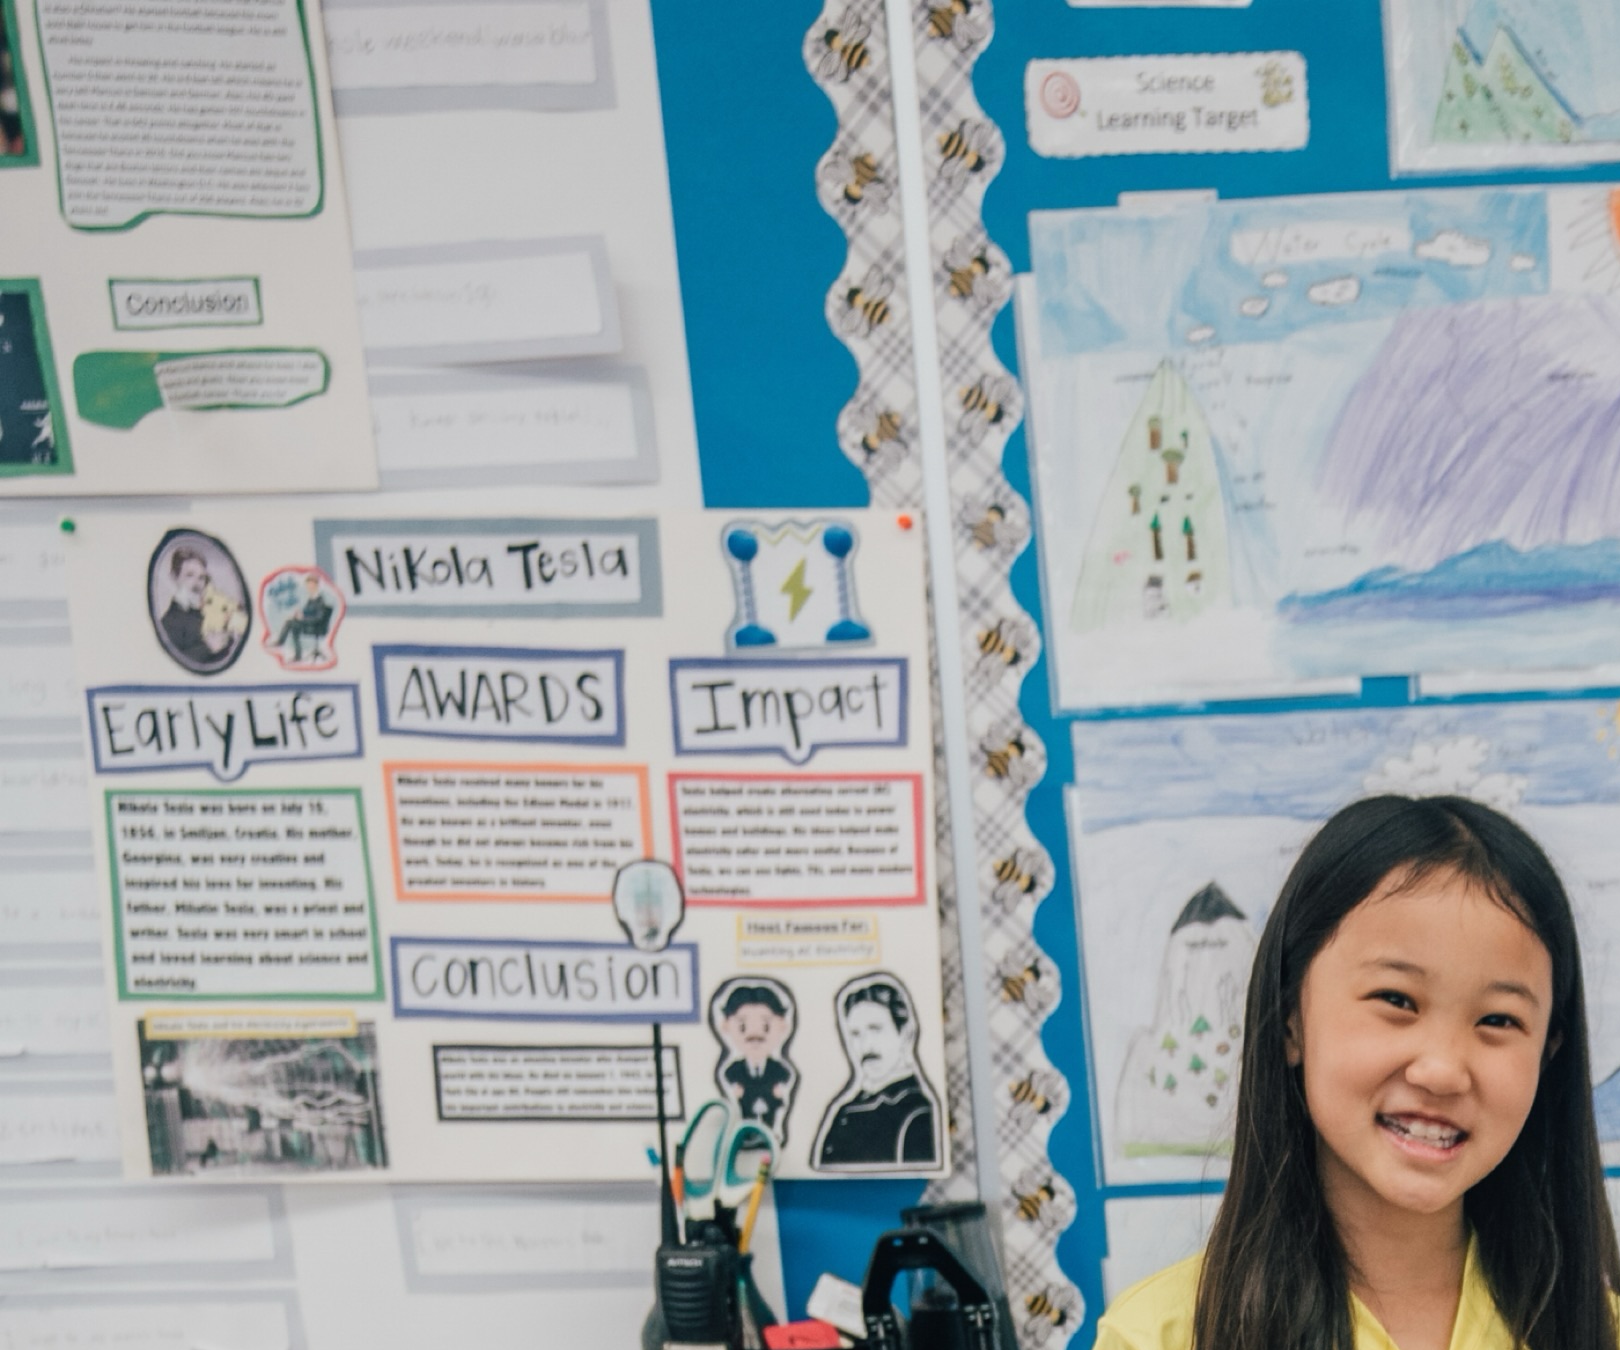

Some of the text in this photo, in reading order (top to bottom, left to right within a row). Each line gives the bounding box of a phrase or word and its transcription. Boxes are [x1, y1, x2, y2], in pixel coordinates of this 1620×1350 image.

[1136, 71, 1216, 95] Science
[1096, 105, 1260, 133] Learning Target
[126, 290, 249, 316] Conclusion
[345, 544, 493, 596] Nikola
[507, 541, 629, 590] Tesla
[399, 665, 605, 724] AWARDS
[691, 674, 889, 750] Impact
[102, 692, 339, 769] Early Life
